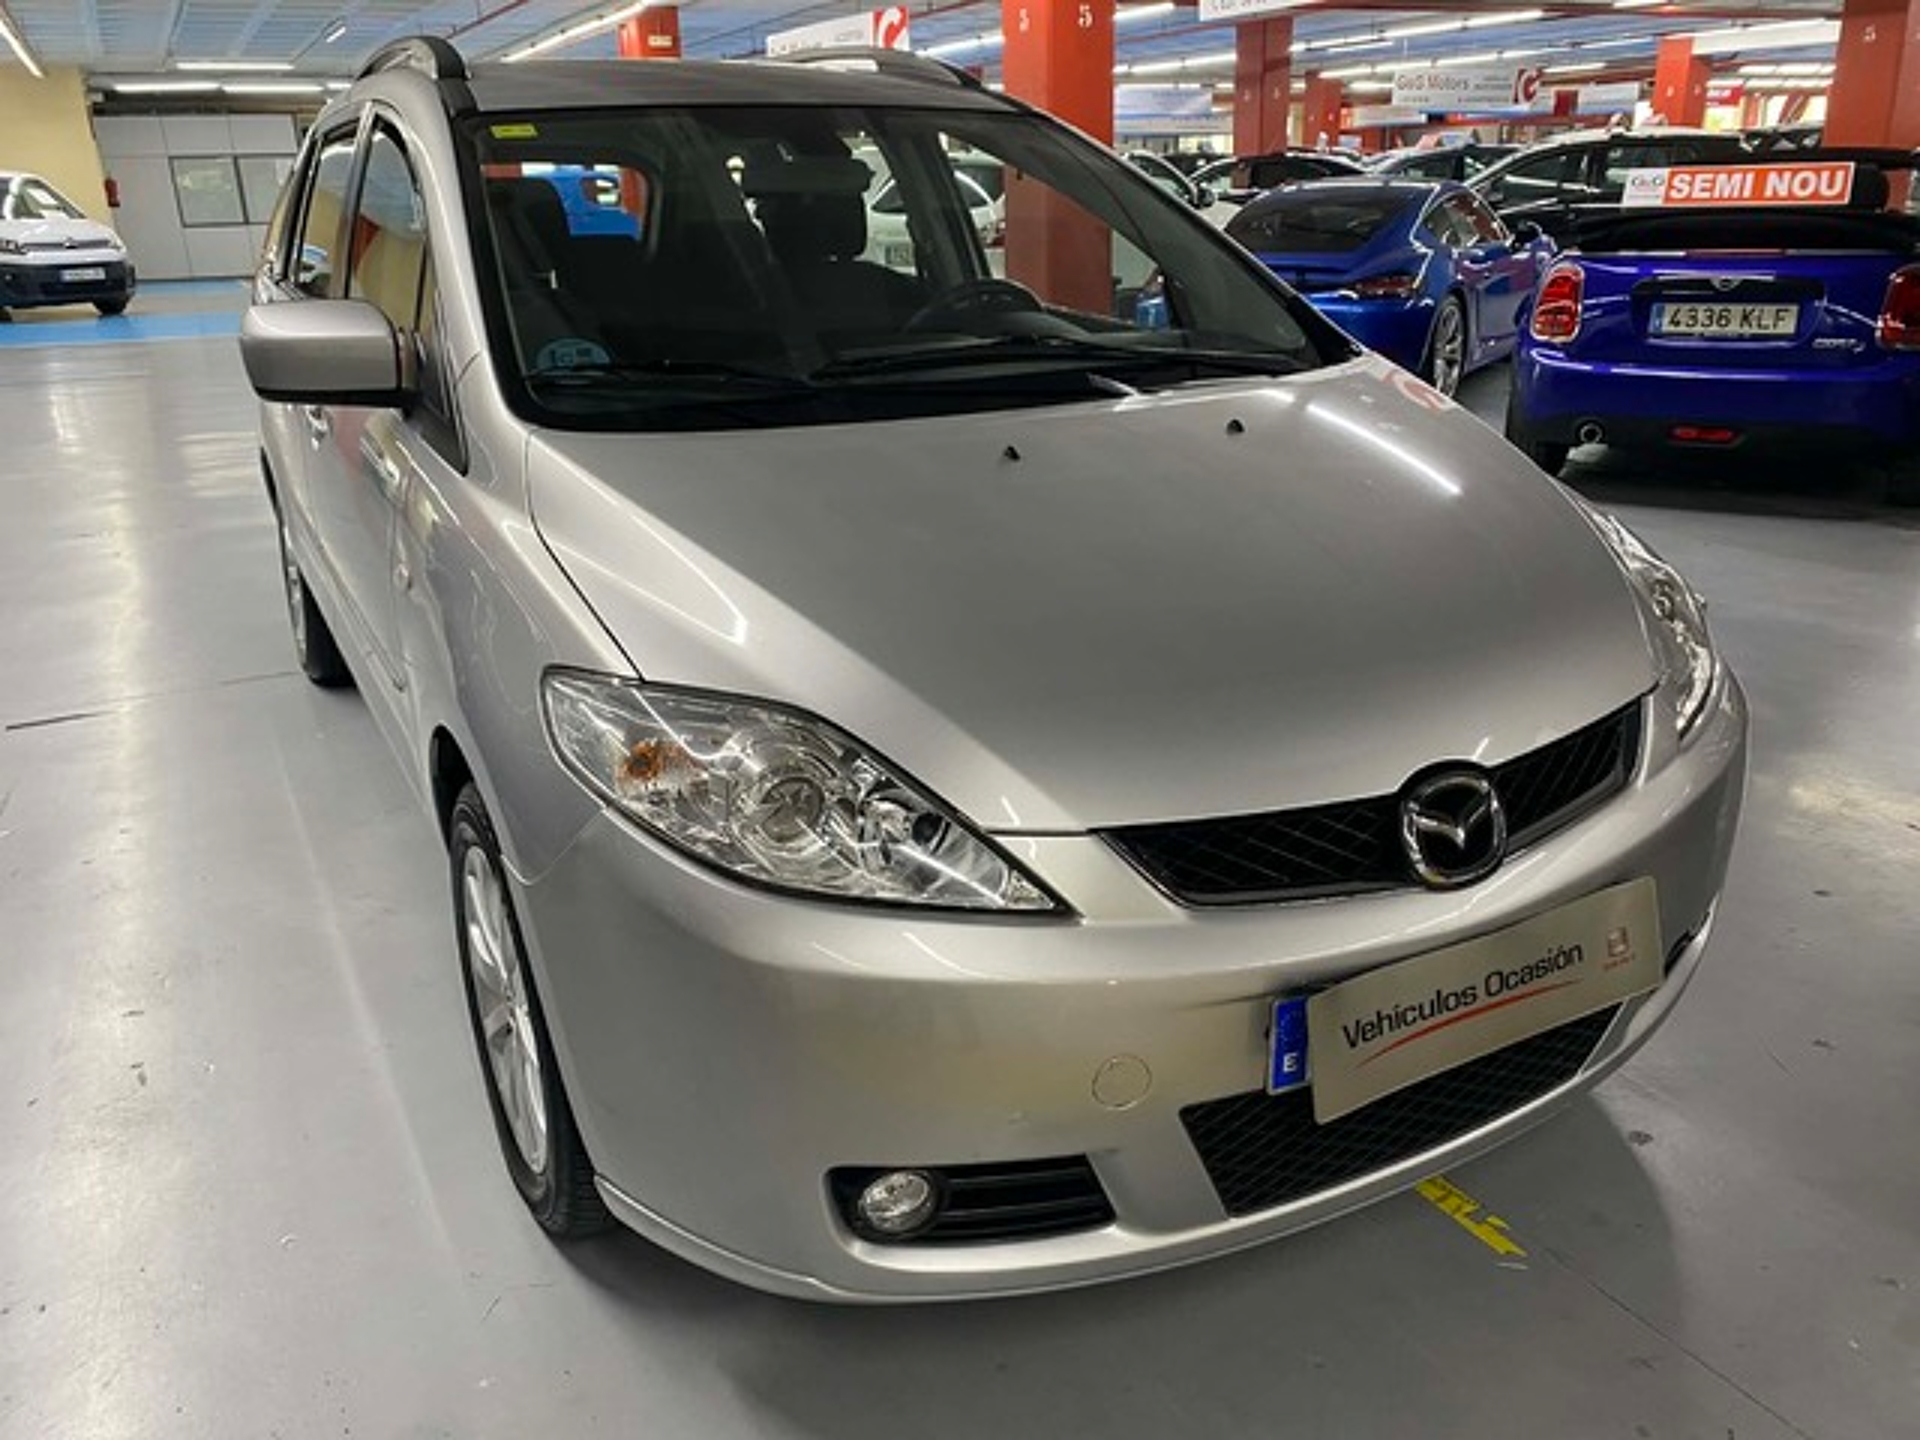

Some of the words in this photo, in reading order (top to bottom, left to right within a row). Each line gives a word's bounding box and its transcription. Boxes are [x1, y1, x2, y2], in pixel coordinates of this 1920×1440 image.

[1079, 4, 1093, 28] 5
[1864, 27, 1876, 43] 5
[1669, 172, 1754, 199] SEMI
[1764, 169, 1846, 197] NOU
[1668, 308, 1732, 329] 4336
[1739, 308, 1790, 330] KLF
[1484, 943, 1584, 997] Ocasión
[1283, 1052, 1298, 1073] E
